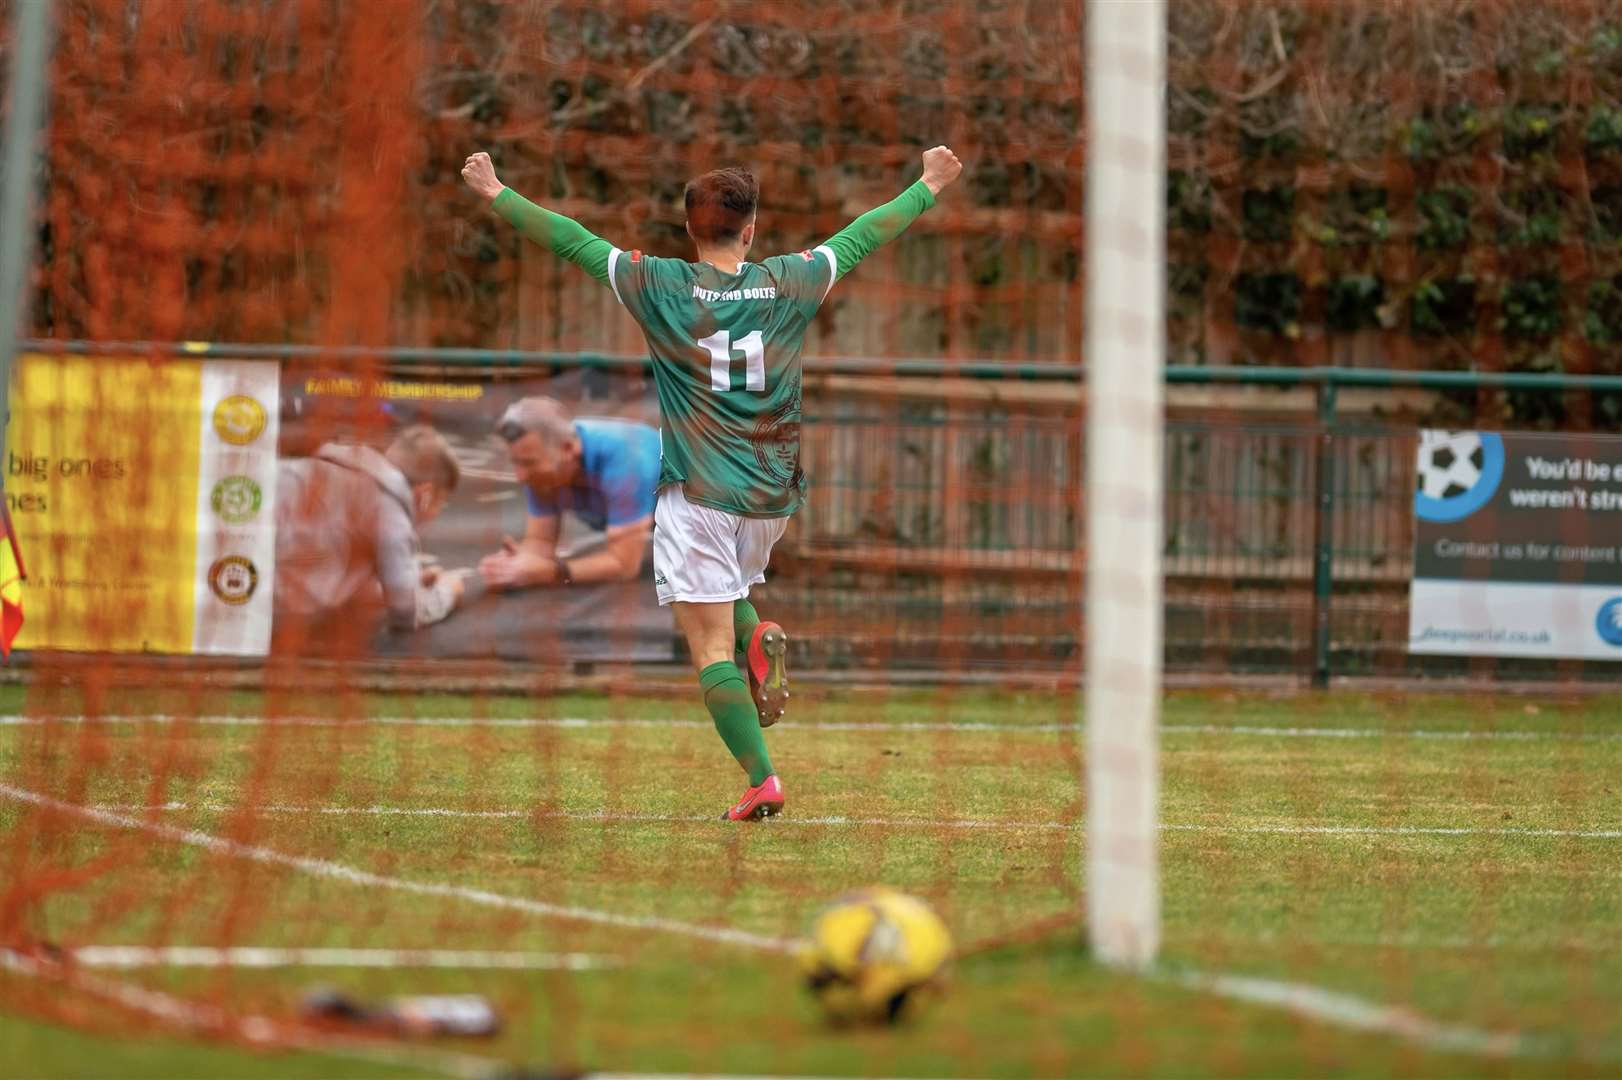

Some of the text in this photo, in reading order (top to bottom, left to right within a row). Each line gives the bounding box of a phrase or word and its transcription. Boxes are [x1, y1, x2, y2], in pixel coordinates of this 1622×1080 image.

[693, 286, 720, 302] NUTS
[743, 287, 776, 299] BOLTS
[698, 330, 765, 391] 11
[59, 457, 125, 480] ones
[1525, 455, 1581, 480] You'd
[1584, 458, 1611, 482] be
[1510, 487, 1586, 510] weren't
[1435, 538, 1499, 558] Contact
[1504, 545, 1523, 559] us
[1526, 542, 1550, 560] for
[1553, 544, 1615, 563] content
